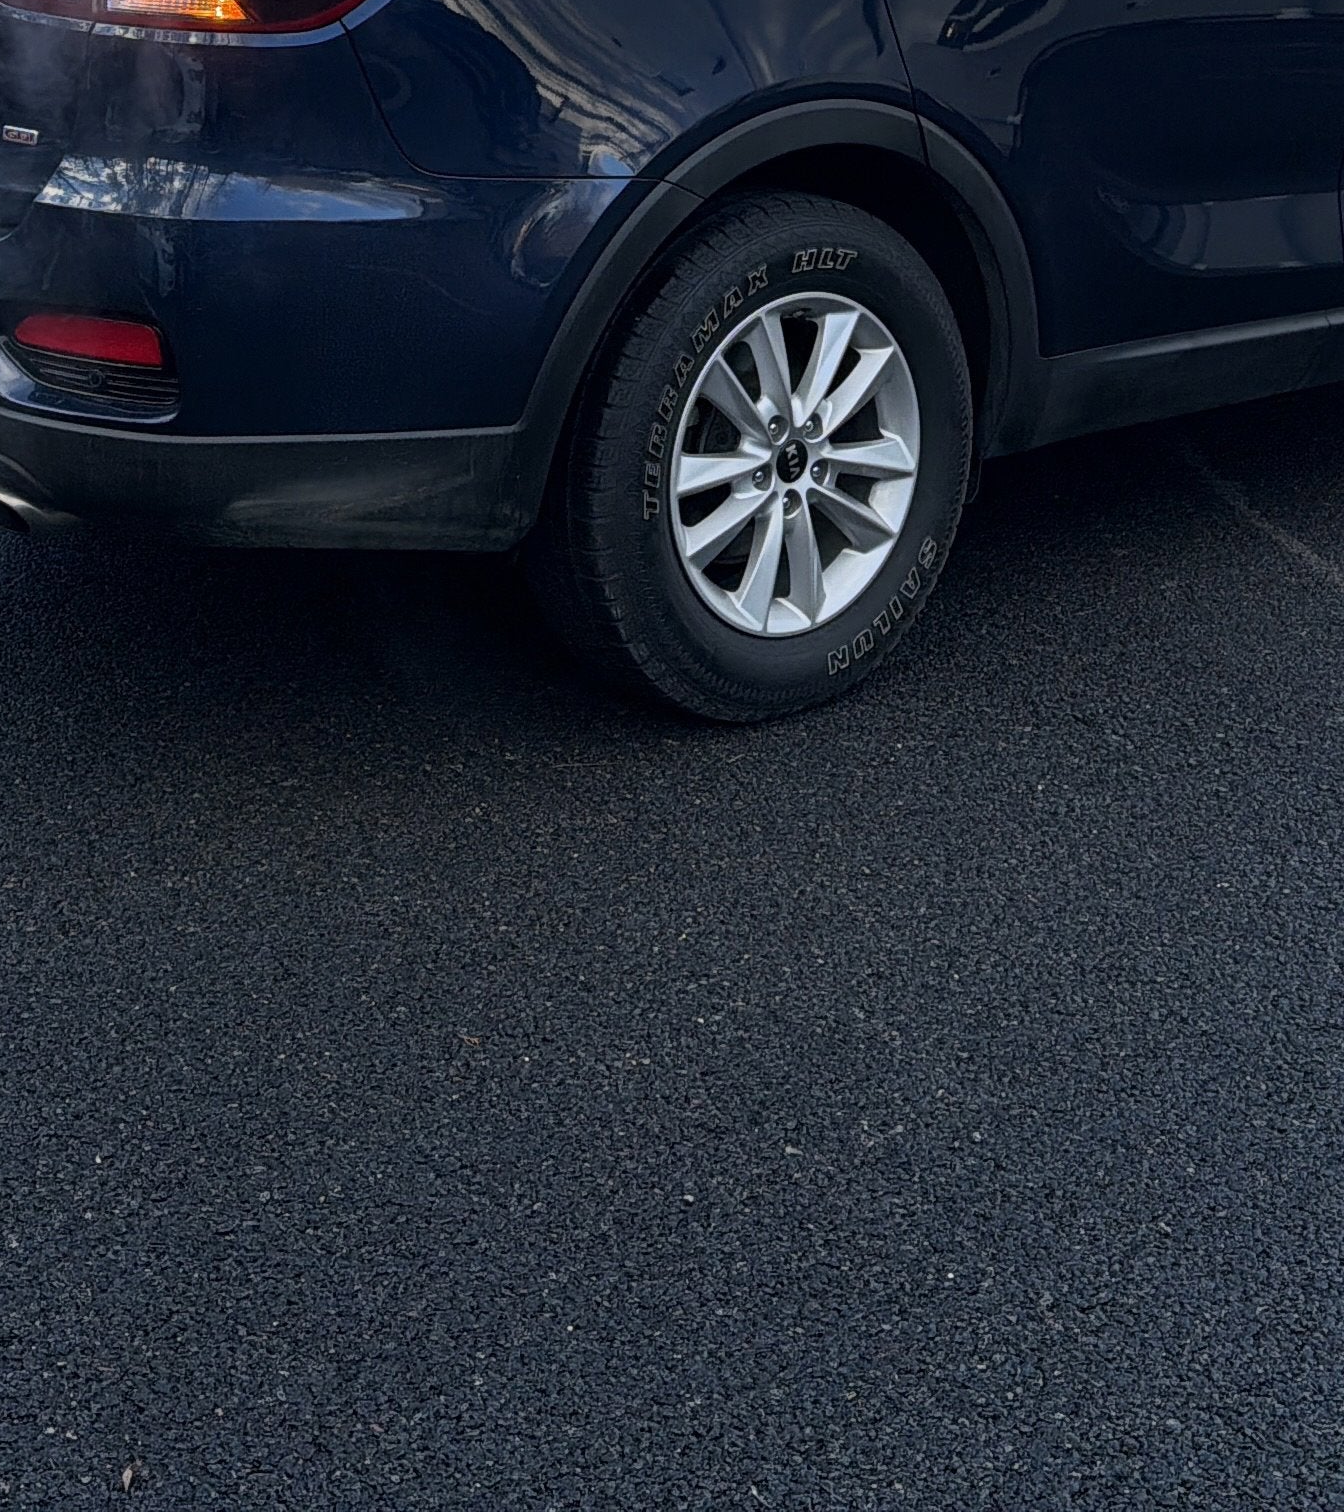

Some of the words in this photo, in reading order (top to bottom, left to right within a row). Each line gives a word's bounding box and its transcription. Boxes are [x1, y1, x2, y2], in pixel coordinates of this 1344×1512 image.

[791, 246, 858, 274] HLT
[643, 263, 769, 521] TERRAMAX
[785, 442, 802, 481] KIA
[827, 535, 939, 677] SAILUN
